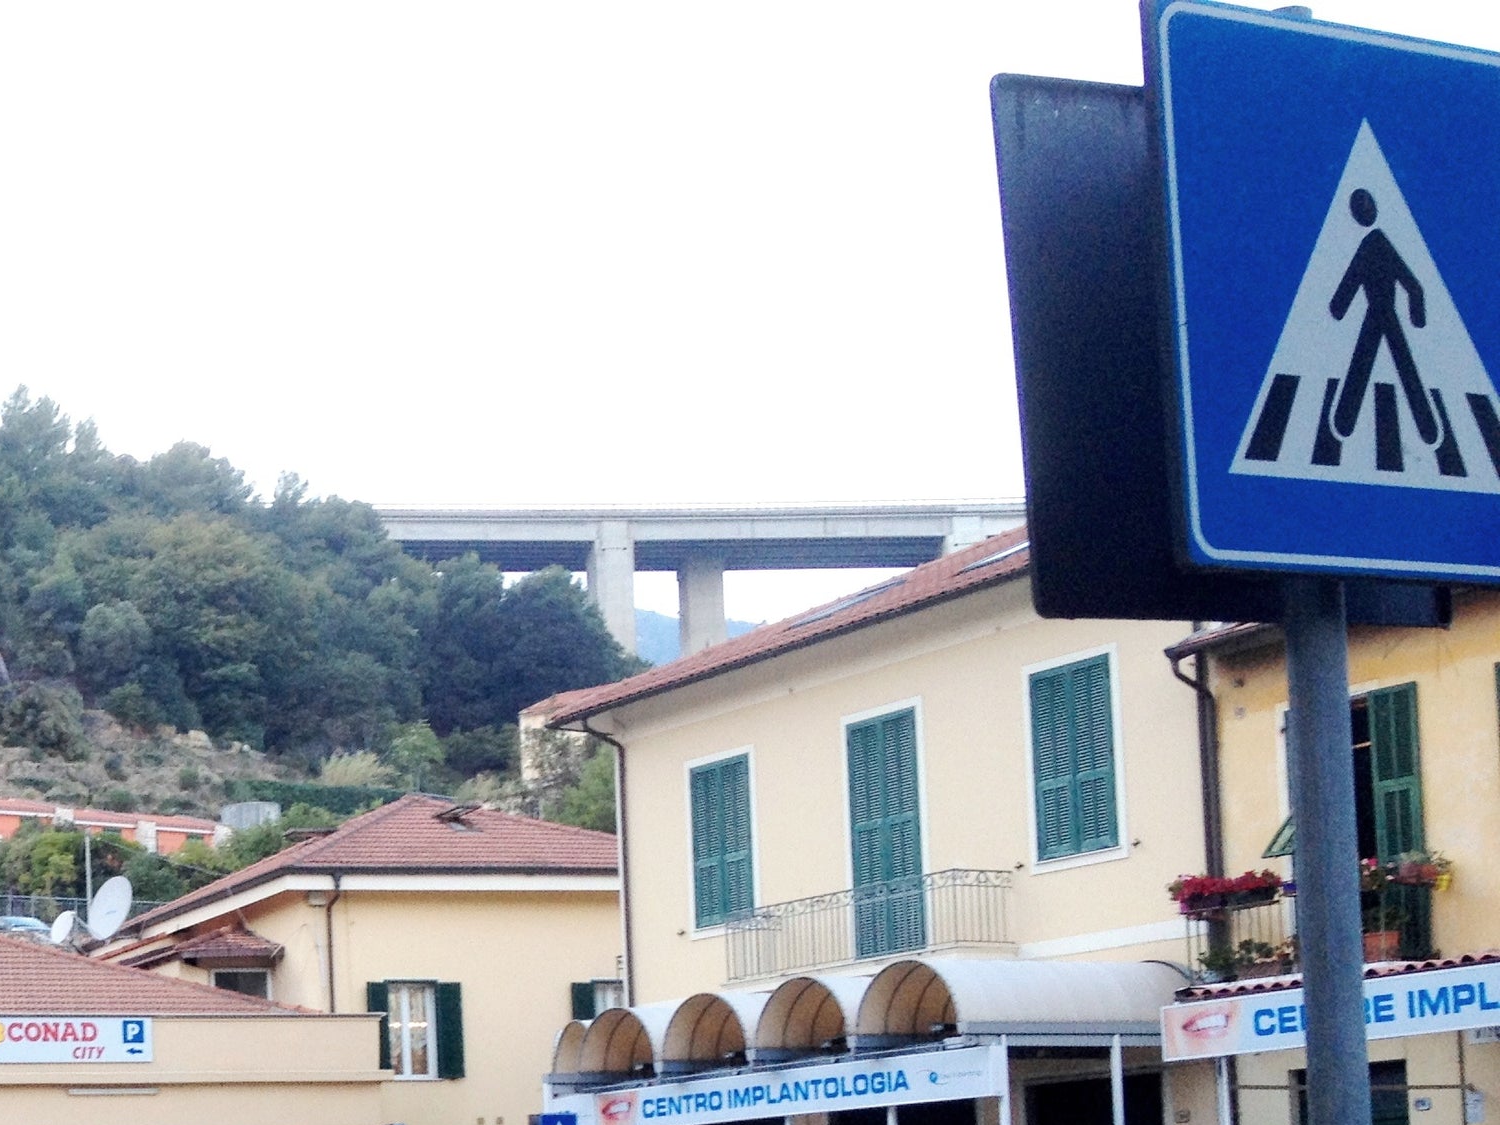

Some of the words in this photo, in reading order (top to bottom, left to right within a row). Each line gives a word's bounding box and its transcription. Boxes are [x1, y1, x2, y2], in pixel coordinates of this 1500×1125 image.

[1254, 993, 1395, 1036] CEE
[7, 1021, 98, 1042] CONAD
[72, 1046, 105, 1060] CITY
[642, 1090, 722, 1119] CENTRO
[728, 1070, 910, 1109] IMPLANTOLOGIA
